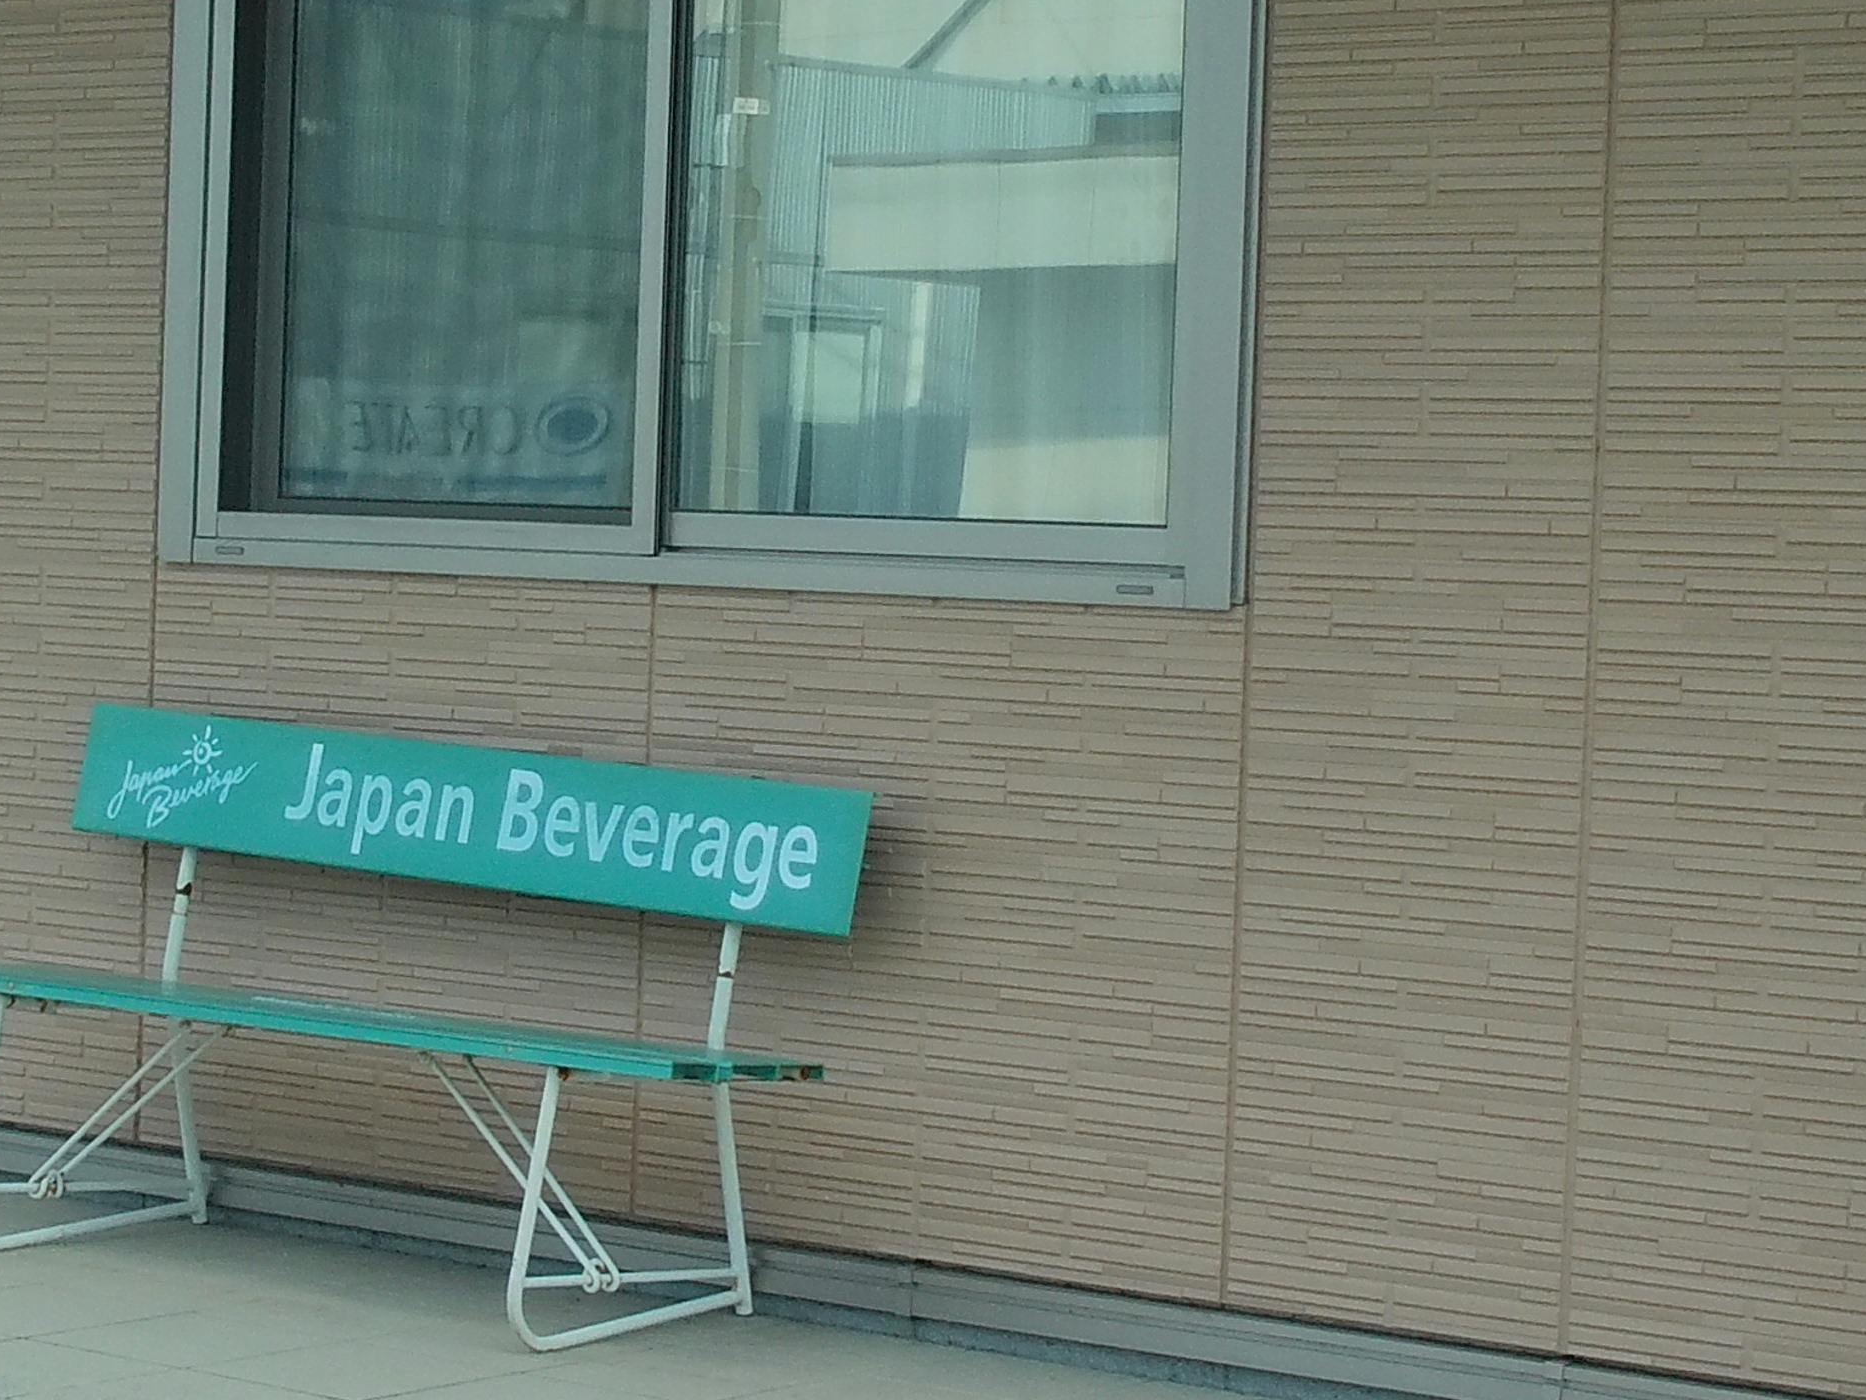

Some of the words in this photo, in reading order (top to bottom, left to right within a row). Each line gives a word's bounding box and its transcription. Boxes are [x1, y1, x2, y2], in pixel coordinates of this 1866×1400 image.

[107, 760, 193, 819] Japan
[142, 761, 258, 828] Beverage
[284, 743, 475, 855] Japan
[496, 768, 819, 911] Beverage
